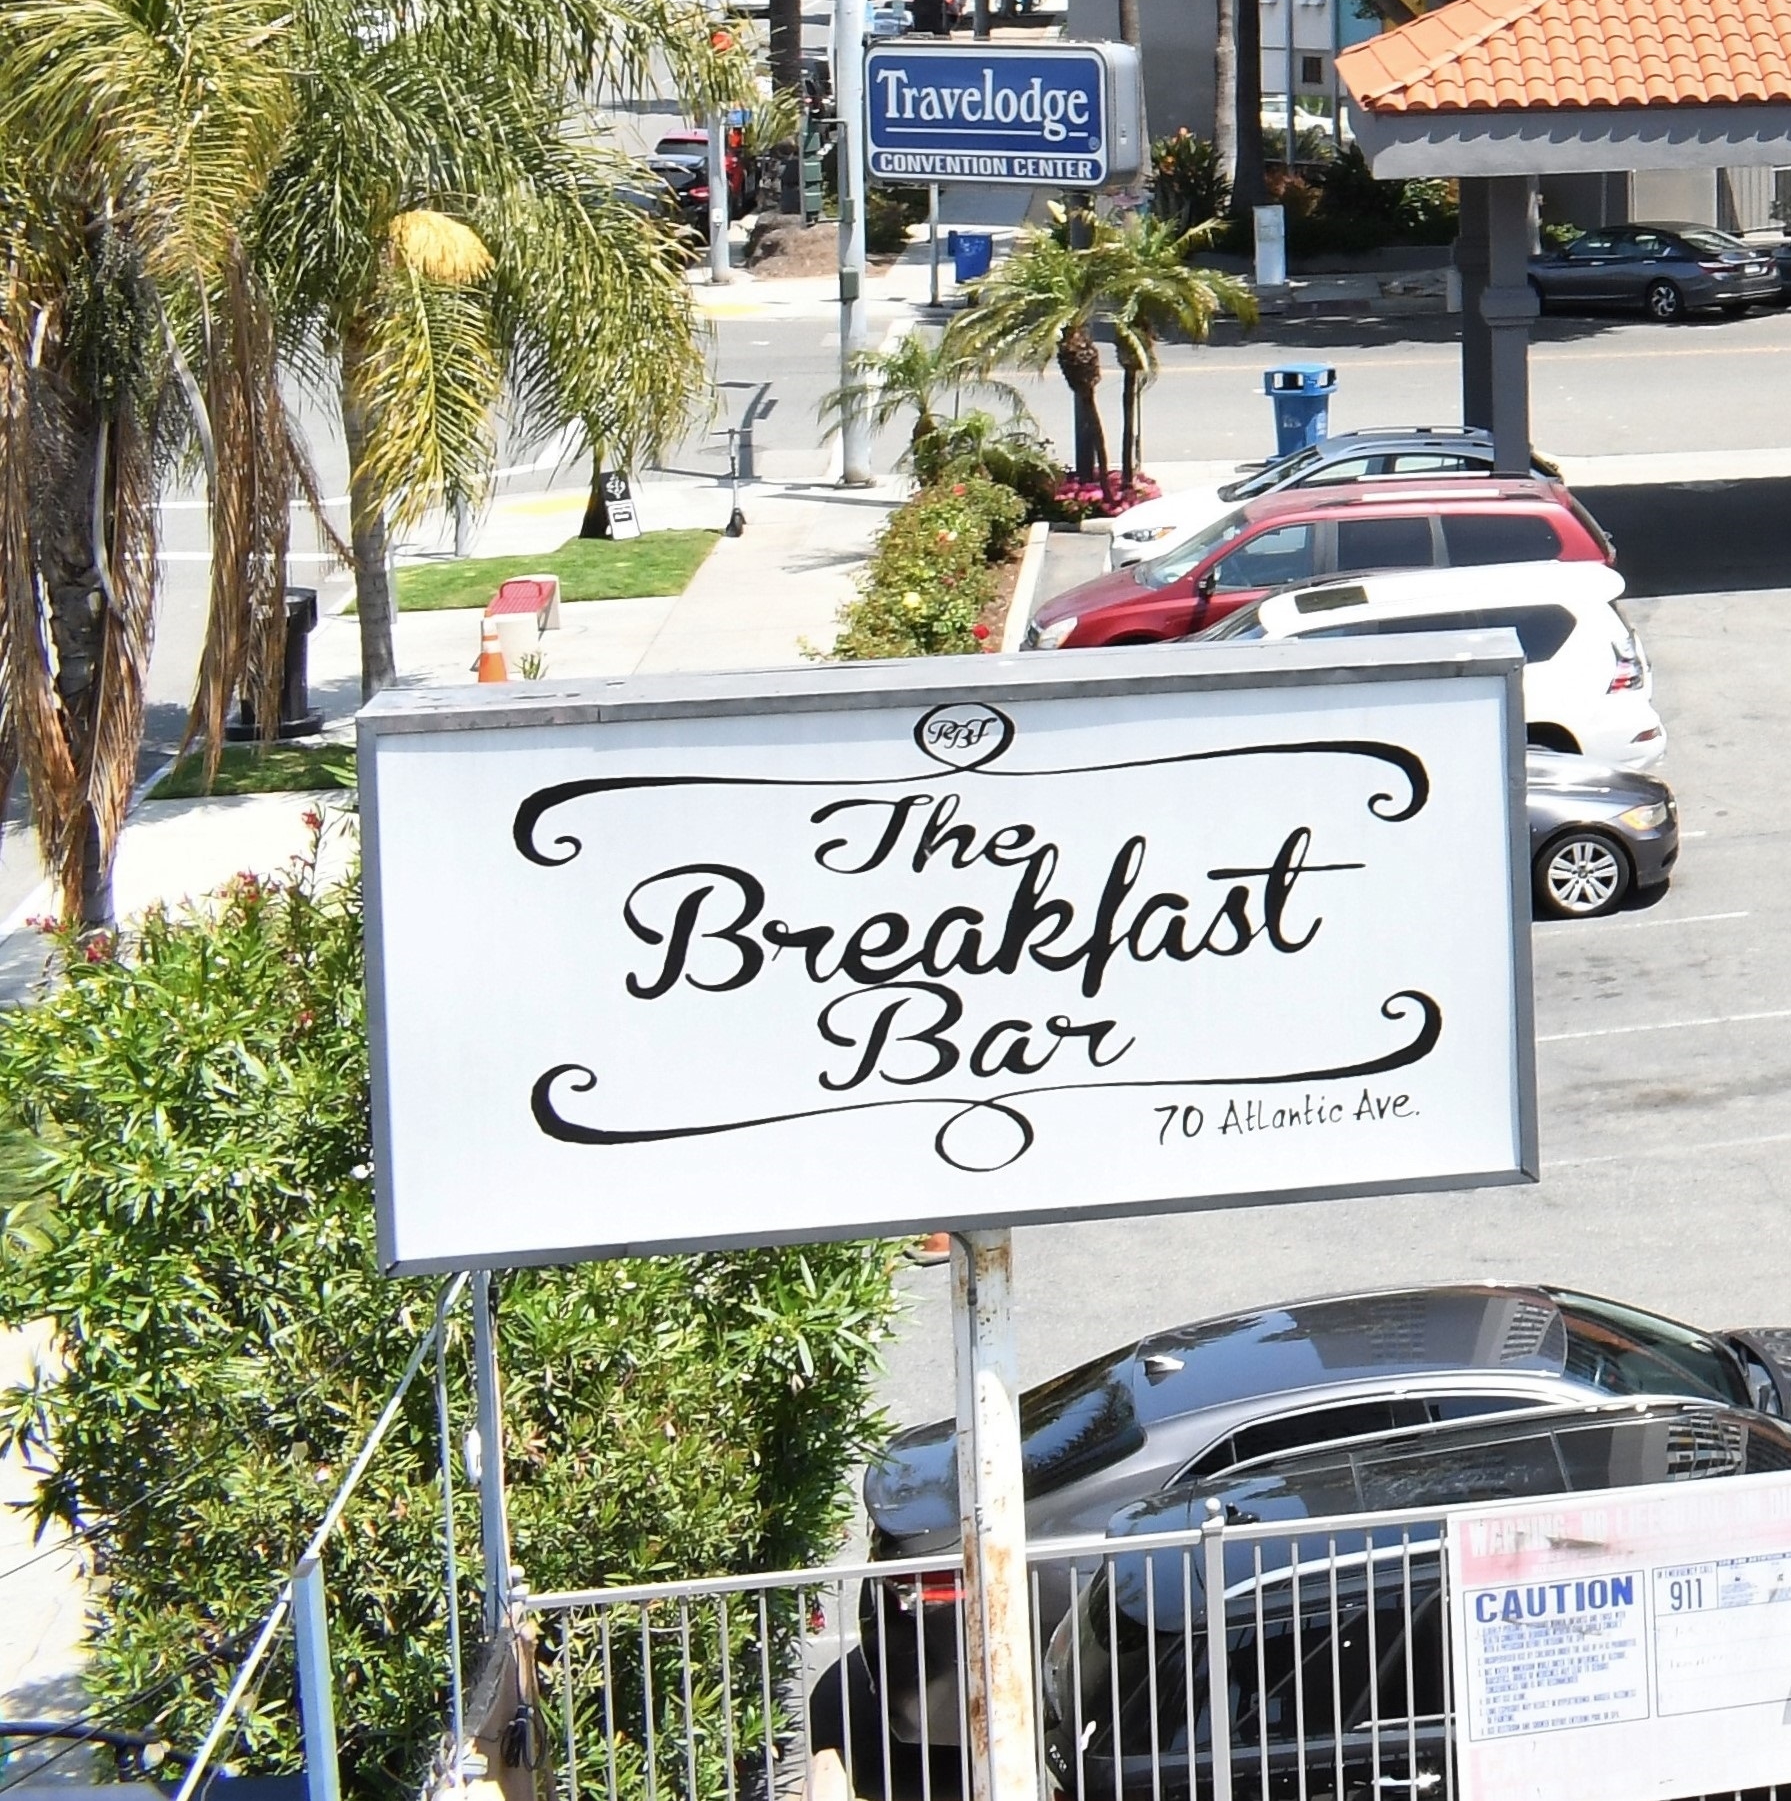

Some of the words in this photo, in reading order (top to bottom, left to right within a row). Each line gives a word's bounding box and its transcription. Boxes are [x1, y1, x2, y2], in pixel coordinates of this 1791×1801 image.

[876, 68, 1089, 141] Travelodge
[880, 153, 1008, 176] CONVENTION
[1013, 157, 1092, 179] CENTER
[810, 793, 1036, 874] The
[624, 826, 1366, 999] Breakfast
[817, 981, 1136, 1091] Bar
[1153, 1104, 1204, 1145] 70
[1353, 1088, 1421, 1121] Ave.
[1475, 1574, 1635, 1623] CAUTION
[1670, 1578, 1702, 1611] 911
